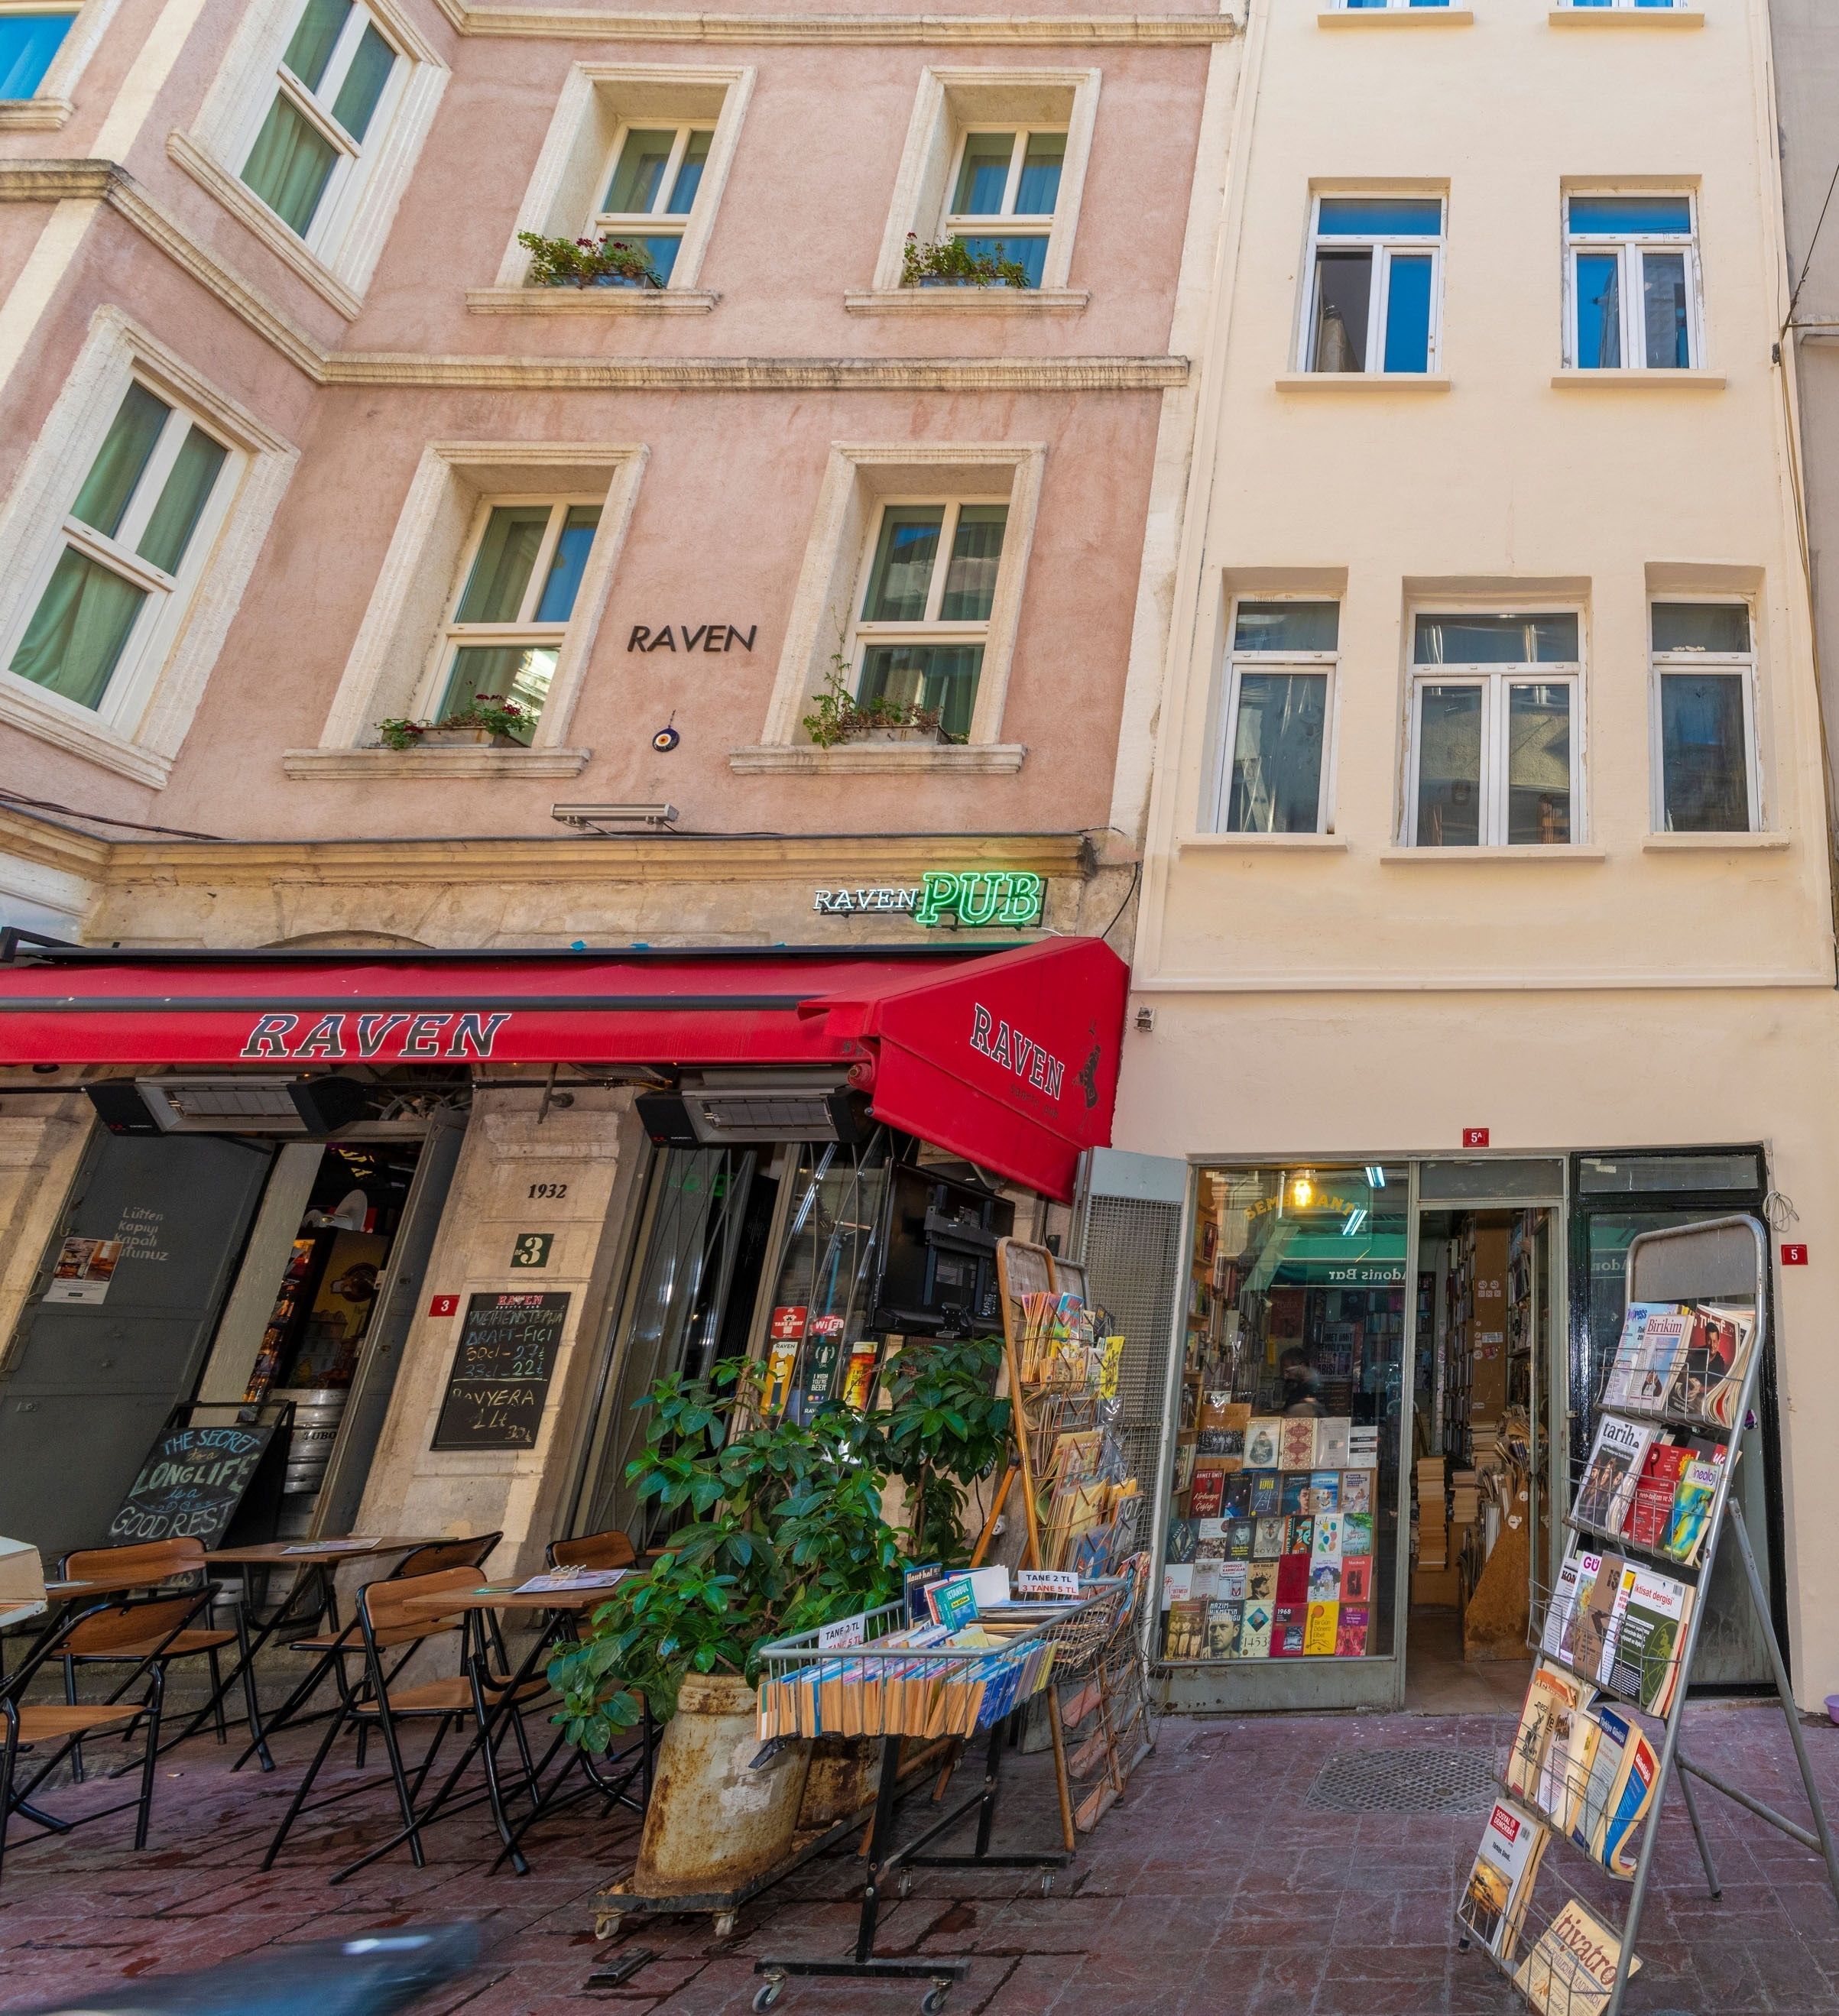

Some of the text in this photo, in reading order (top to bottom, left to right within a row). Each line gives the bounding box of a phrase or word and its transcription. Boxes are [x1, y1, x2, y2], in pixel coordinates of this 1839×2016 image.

[628, 625, 757, 653] RAVEN
[813, 871, 1040, 925] RAVEN PUB
[239, 1013, 512, 1058] RAVEN
[970, 1003, 1065, 1100] RAVEN
[527, 1184, 567, 1199] 1932
[120, 1245, 169, 1261] utunuz
[520, 1237, 543, 1264] 3
[1791, 1249, 1798, 1260] 5
[440, 1300, 450, 1311] 3
[497, 1295, 543, 1305] RAVEN
[1647, 1319, 1682, 1333] Birikim
[162, 1429, 261, 1455] THE SECRET
[129, 1454, 260, 1497] LONG LIFE
[111, 1499, 236, 1538] GOOD REST
[825, 1622, 860, 1640] TANE 2 TL
[855, 1635, 861, 1644] TL
[1244, 1636, 1267, 1647] 1453
[1494, 1817, 1515, 1836] DEMOKRAT
[1496, 1810, 1511, 1826] SOSYAL
